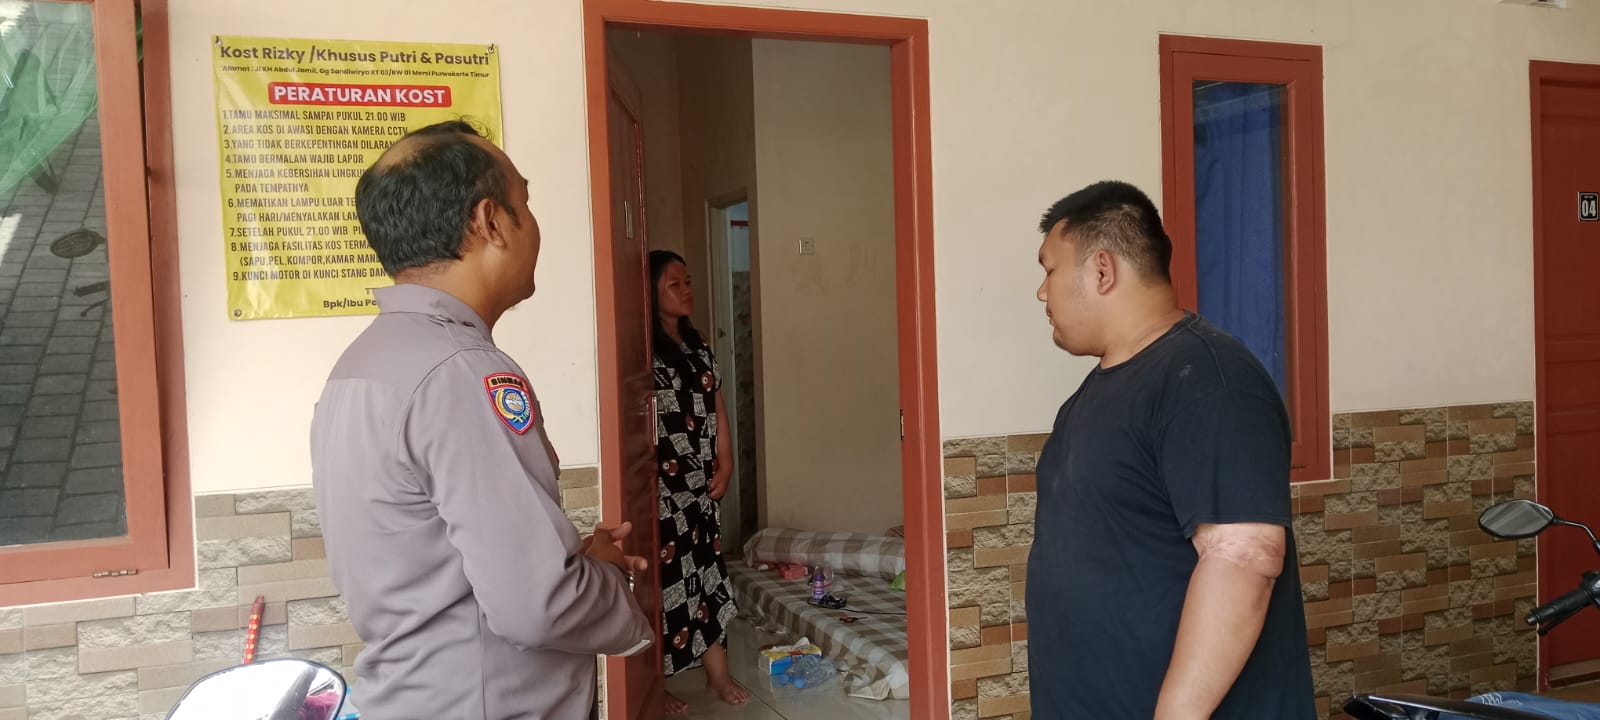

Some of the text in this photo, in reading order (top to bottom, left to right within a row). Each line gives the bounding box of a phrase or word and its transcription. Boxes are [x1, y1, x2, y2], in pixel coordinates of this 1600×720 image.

[220, 45, 489, 65] Kost Rizky /Khusus Putri & Pasutri
[273, 86, 445, 104] PERATURAN KOST
[254, 110, 300, 120] MAKSIMAL
[302, 111, 334, 120] SAMPAI
[336, 112, 364, 120] PUKUL
[365, 112, 388, 121] 21.00
[390, 112, 406, 121] WIB
[256, 125, 273, 134] KOS
[276, 125, 284, 134] DI
[288, 125, 314, 134] AWASI
[316, 126, 349, 135] DENGAN
[352, 126, 385, 136] KAMERA
[388, 126, 408, 136] CCTV
[258, 140, 282, 149] TIDAK
[284, 139, 358, 149] BERKEPENTINGAN
[260, 154, 307, 163] BERMALAM
[310, 154, 335, 163] WAJIB
[337, 154, 364, 163] LAPOR
[277, 168, 330, 178] KEBERSIHAN
[235, 183, 309, 193] PADA TEMPATNYA
[290, 198, 320, 207] LAMPU
[322, 197, 343, 207] LUAR
[1582, 200, 1596, 216] 04
[237, 213, 256, 222] PAGI
[259, 212, 340, 222] HARI/MENYALAKAN
[277, 227, 304, 236] PUKUL
[306, 226, 329, 236] 21.00
[332, 226, 348, 235] WIB
[282, 241, 323, 251] FASILITAS
[325, 240, 341, 250] KOS
[271, 270, 300, 280] MOTOR
[303, 270, 310, 279] DI
[314, 269, 338, 279] KUNCI
[341, 268, 367, 278] STANG
[370, 268, 386, 277] DAN
[323, 298, 363, 310] Bpk/Ibu
